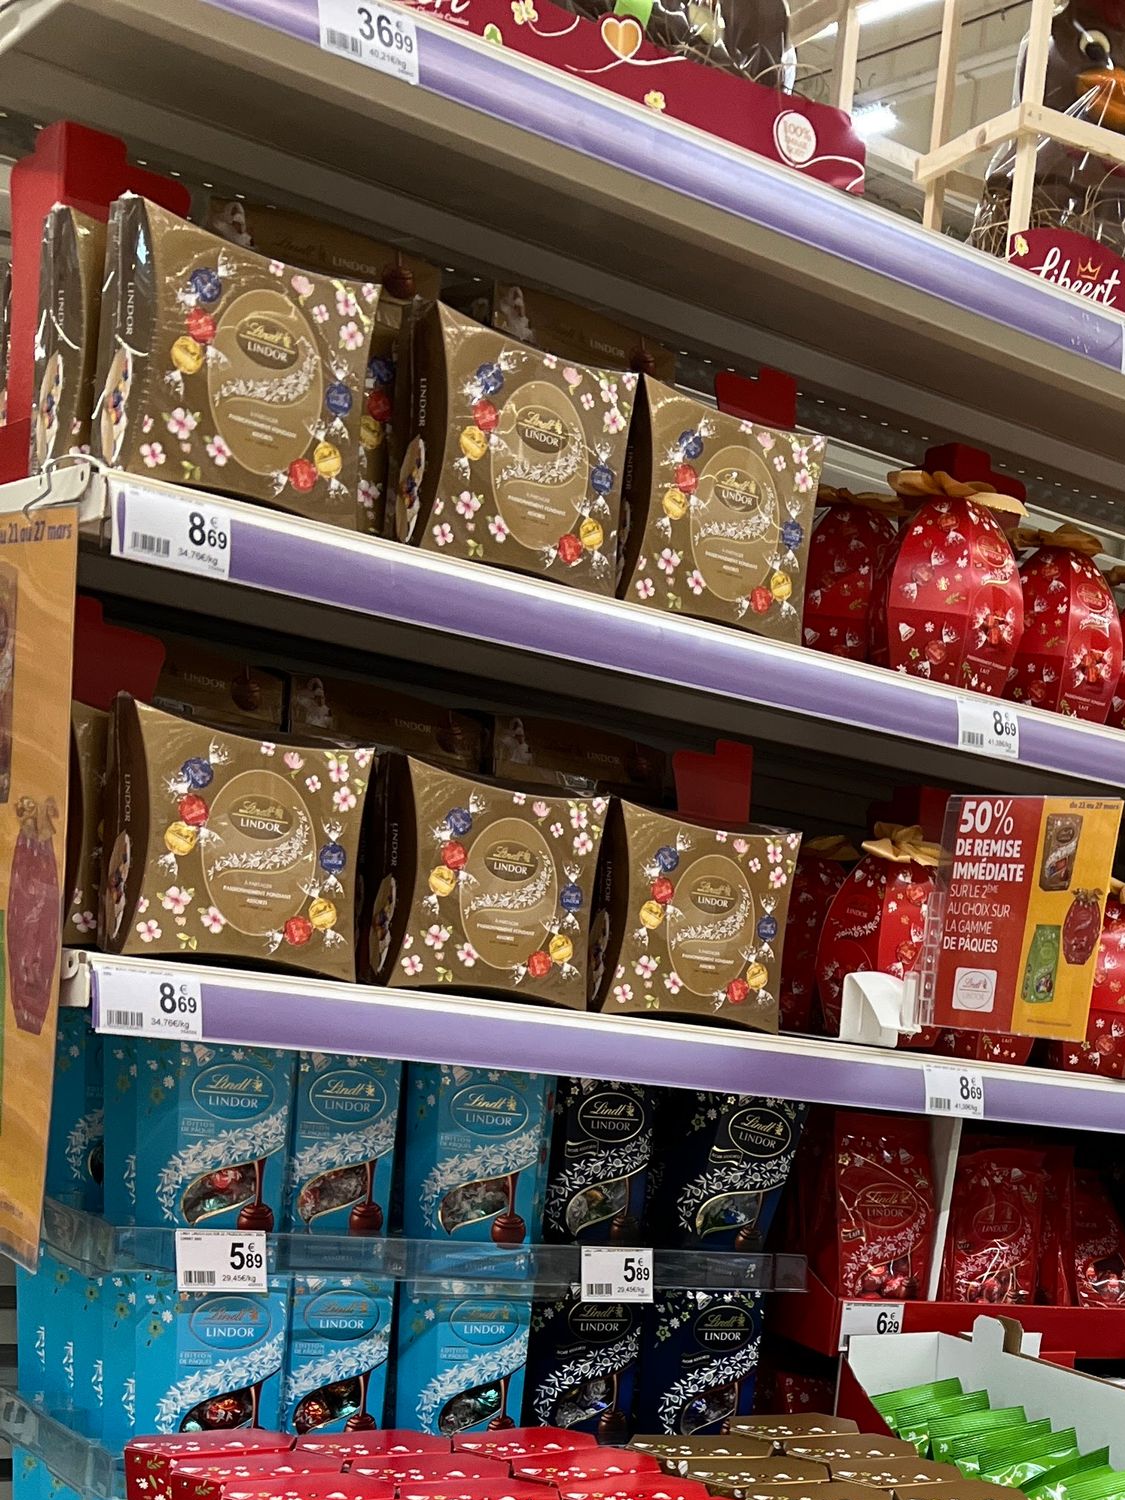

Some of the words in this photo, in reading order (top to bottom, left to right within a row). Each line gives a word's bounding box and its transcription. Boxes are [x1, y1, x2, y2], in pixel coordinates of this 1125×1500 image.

[126, 282, 135, 336] LINDOR
[247, 342, 288, 362] LINDOR
[47, 523, 72, 541] mars
[959, 799, 1014, 835] 50%
[240, 818, 283, 834] LINDOR
[955, 840, 974, 857] DE
[974, 840, 1022, 858] REMISE
[953, 858, 1025, 882] IMMÉDIATE
[950, 884, 968, 898] SUR
[969, 885, 981, 898] LE
[947, 902, 962, 915] AU
[962, 902, 991, 917] CHOIX
[992, 903, 1010, 918] SUR
[945, 920, 958, 932] LA
[958, 920, 992, 934] GAMME
[943, 936, 957, 950] DE
[958, 935, 998, 953] PÂQUES
[209, 1096, 258, 1109] LINDOR
[466, 1113, 512, 1126] LINDOR
[591, 1120, 630, 1131] LINDOR
[739, 1133, 776, 1149] LINDOR
[867, 1206, 904, 1217] LINDOR
[206, 1325, 255, 1338] LINDOR
